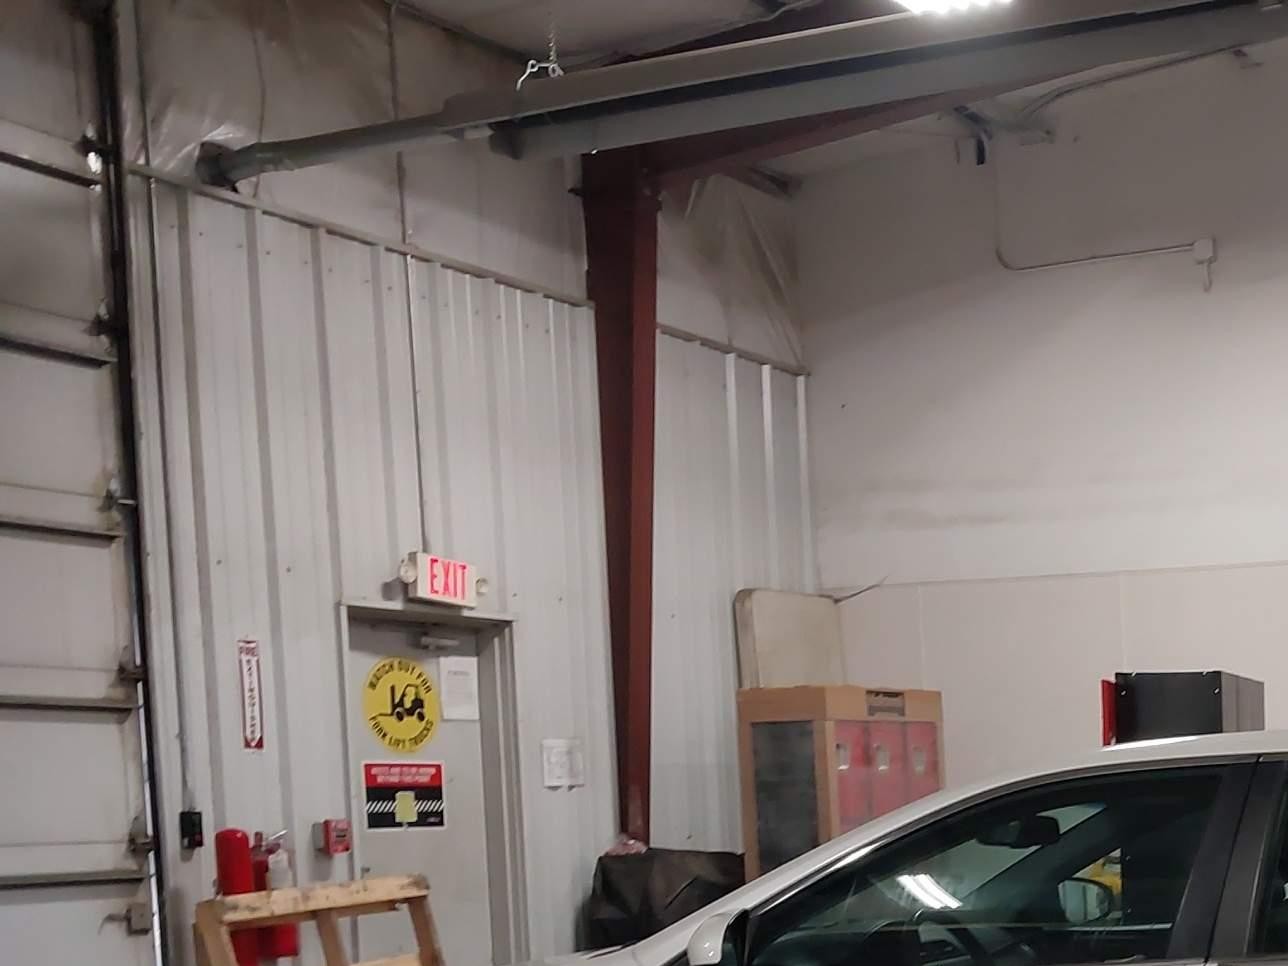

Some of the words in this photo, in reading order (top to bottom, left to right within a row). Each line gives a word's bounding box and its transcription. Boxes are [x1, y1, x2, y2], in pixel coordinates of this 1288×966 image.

[429, 557, 467, 601] EXIT
[366, 660, 394, 690] WATCH
[398, 660, 417, 676] OUT
[415, 671, 433, 694] FOR
[367, 717, 388, 740] FORK
[388, 736, 406, 749] LIFT
[407, 719, 434, 746] TRUCKS
